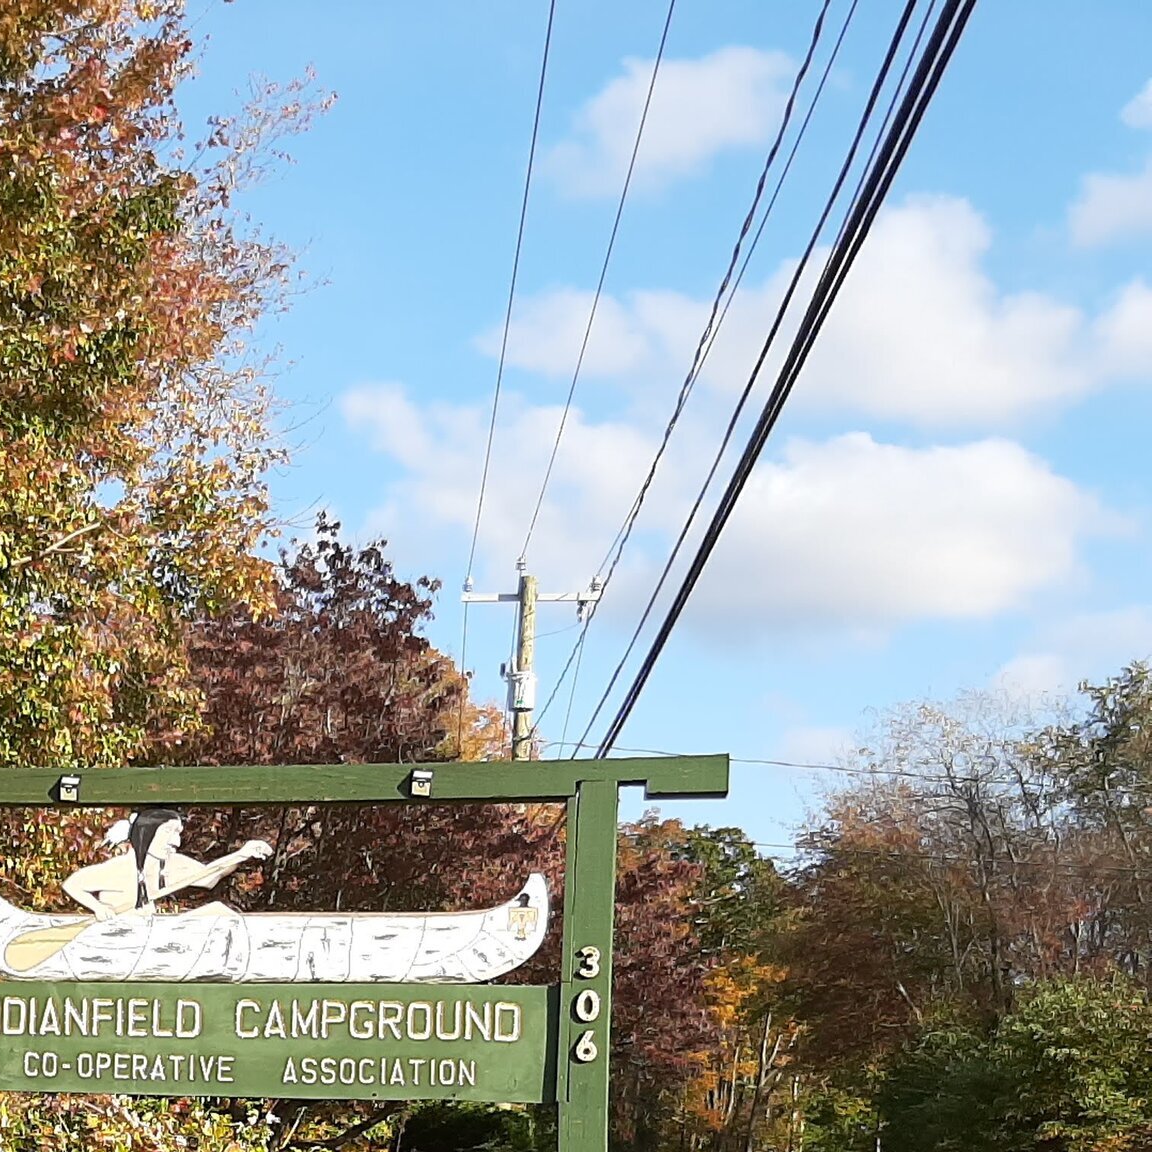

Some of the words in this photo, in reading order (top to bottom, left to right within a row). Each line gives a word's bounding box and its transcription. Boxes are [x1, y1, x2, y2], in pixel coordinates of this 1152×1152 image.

[234, 998, 523, 1043] CAMPGROUND
[574, 945, 601, 1062] 306
[23, 1052, 235, 1082] CO-OPERATIVE
[282, 1056, 478, 1087] ASSOCIATION
